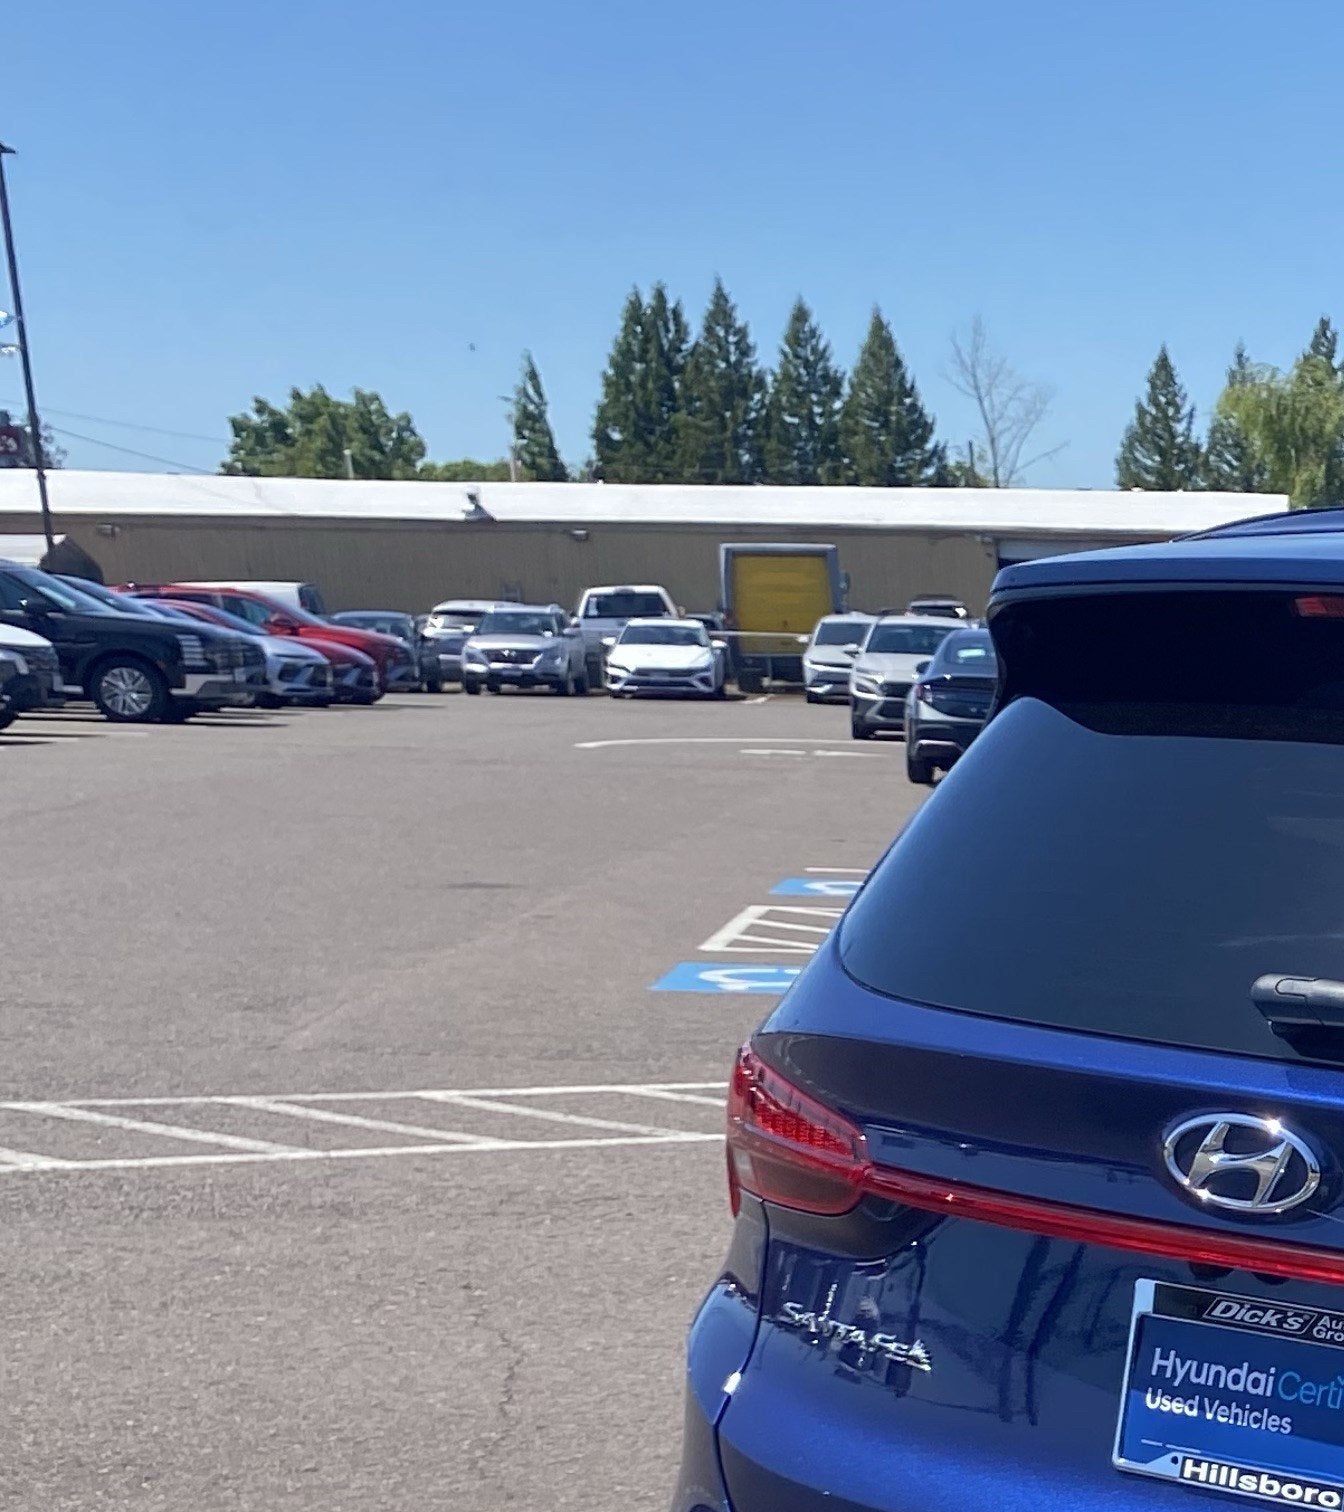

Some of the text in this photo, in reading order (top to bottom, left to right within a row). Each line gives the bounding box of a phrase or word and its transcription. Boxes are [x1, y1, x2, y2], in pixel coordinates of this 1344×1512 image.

[1211, 1299, 1305, 1332] Dick's
[1150, 1347, 1276, 1398] Hyundai
[1145, 1387, 1293, 1435] Used Vehicles
[1183, 1458, 1342, 1508] Hillsboro
